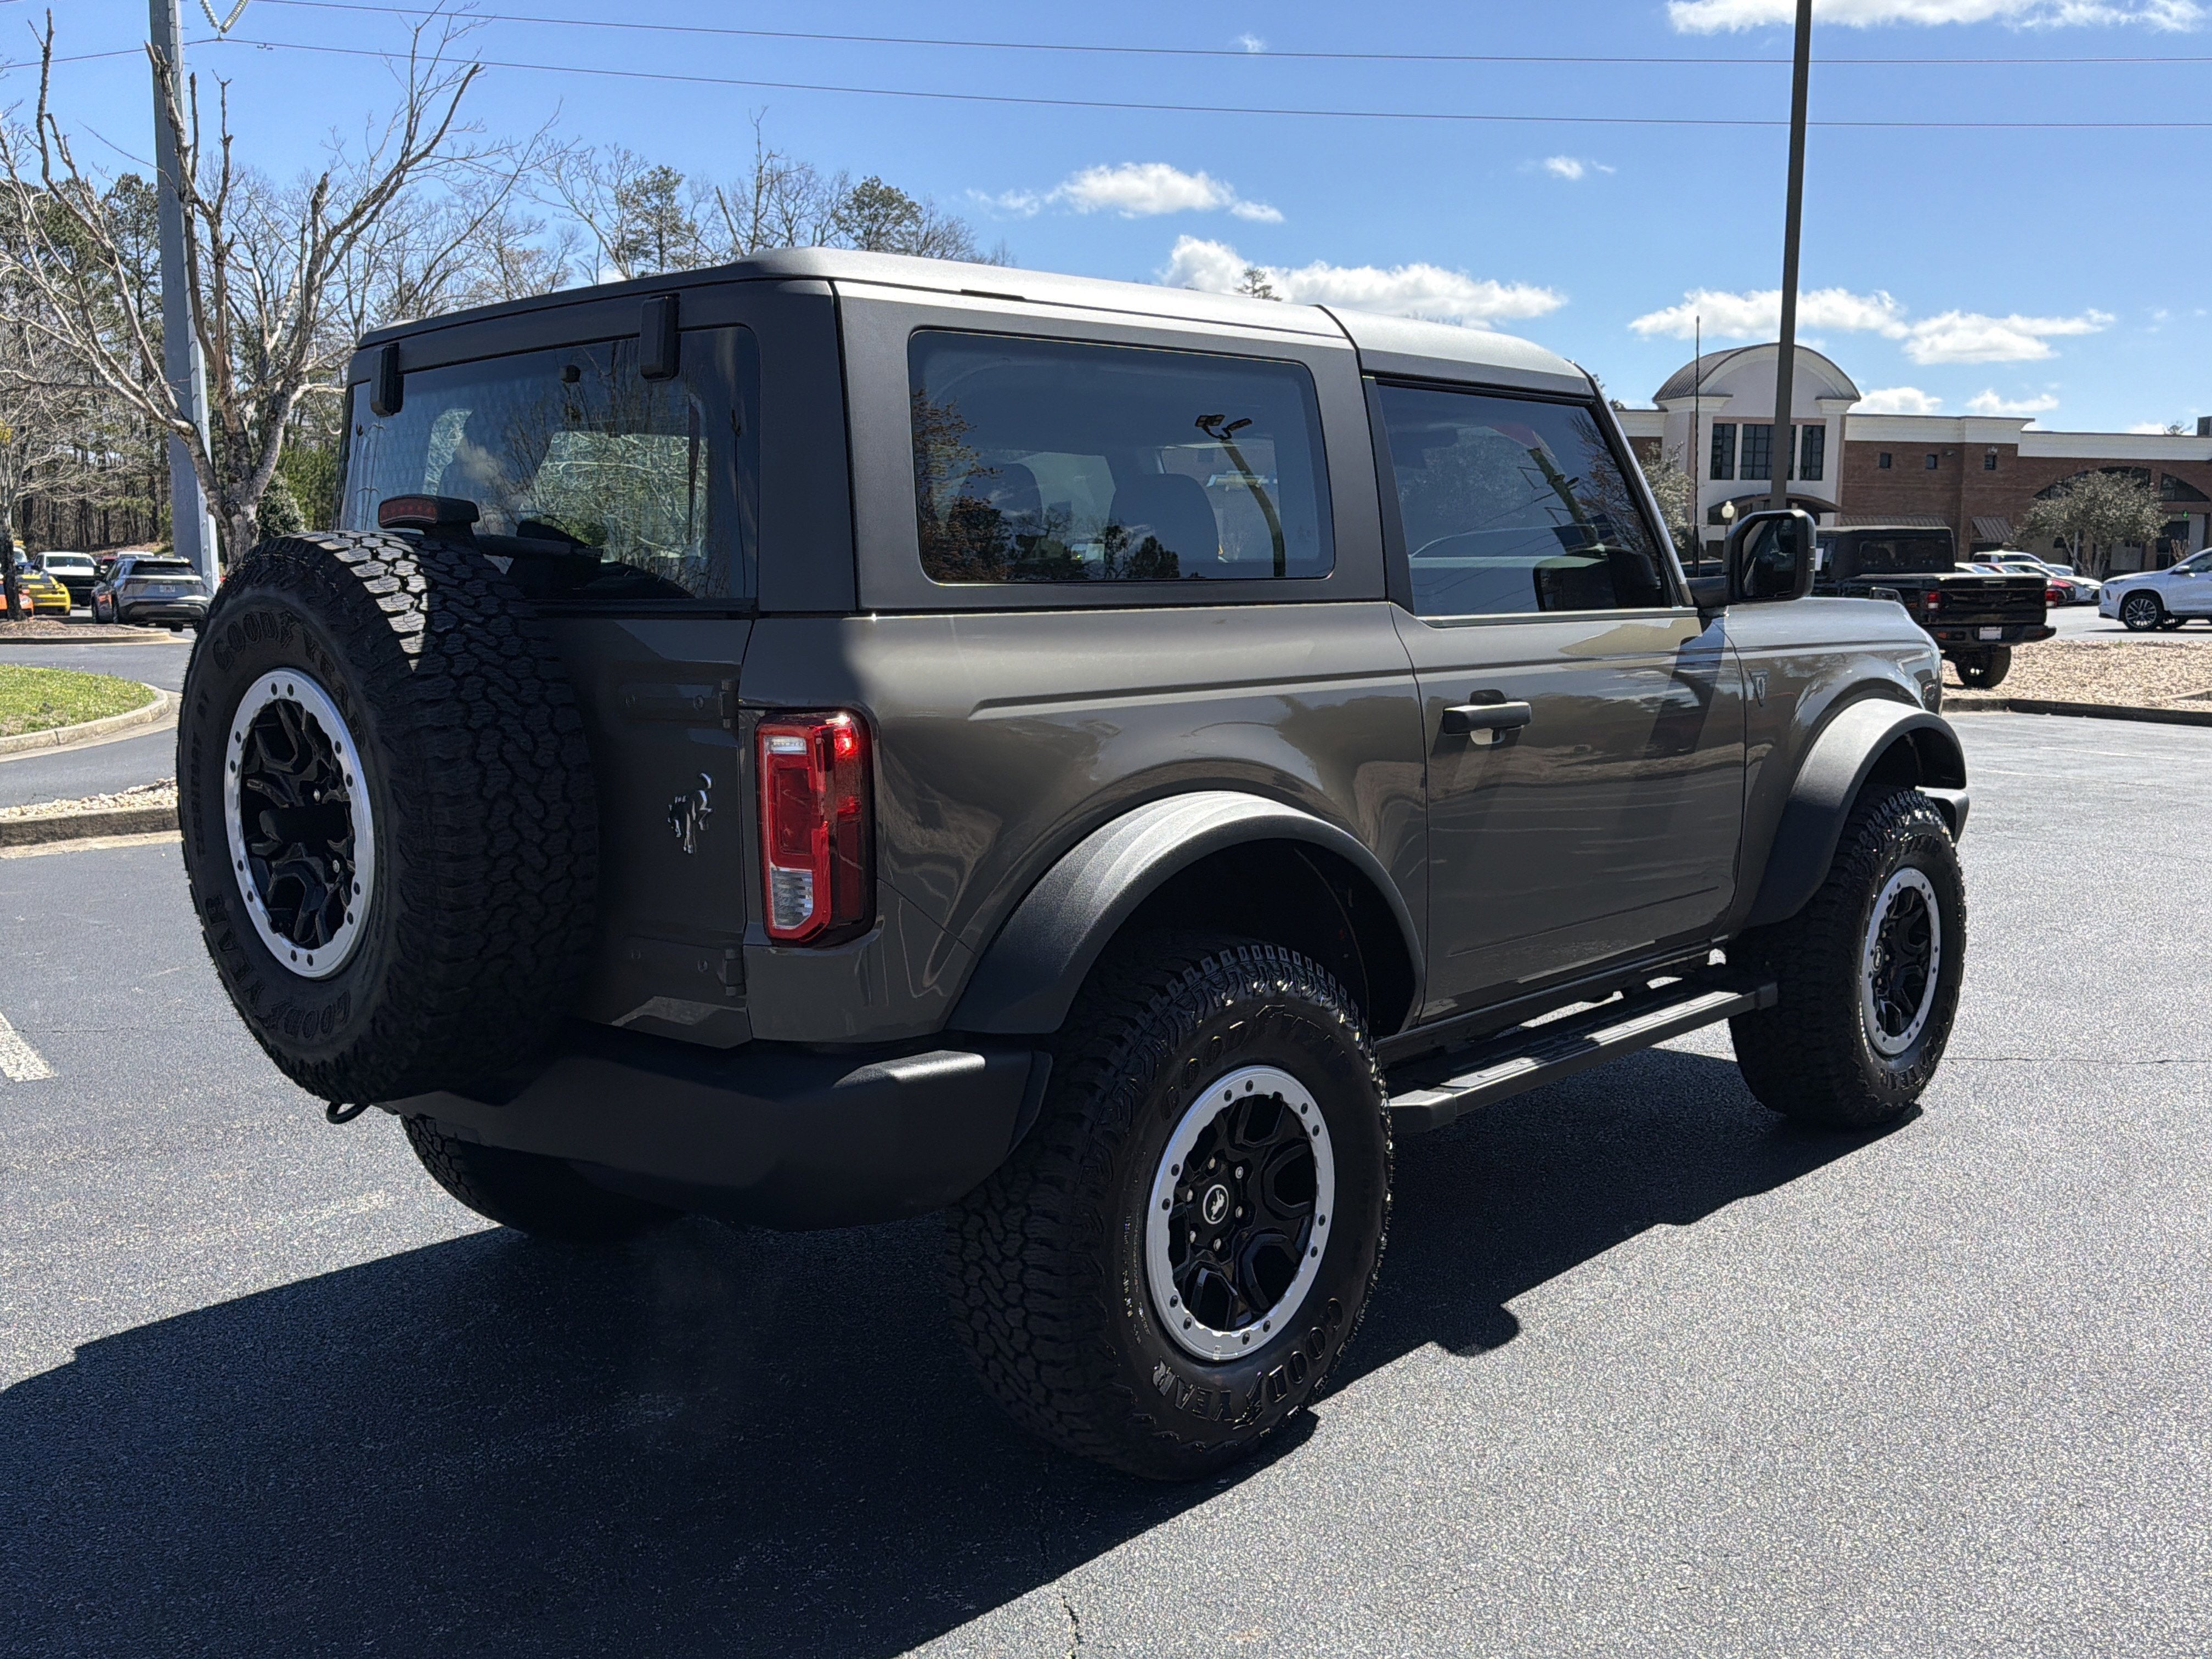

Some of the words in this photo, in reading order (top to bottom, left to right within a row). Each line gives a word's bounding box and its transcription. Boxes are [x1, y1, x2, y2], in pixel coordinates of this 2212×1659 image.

[213, 610, 365, 751] GOODYEAR
[205, 893, 351, 1040] GOODYEAR
[1152, 1296, 1344, 1430] GOODYEAR
